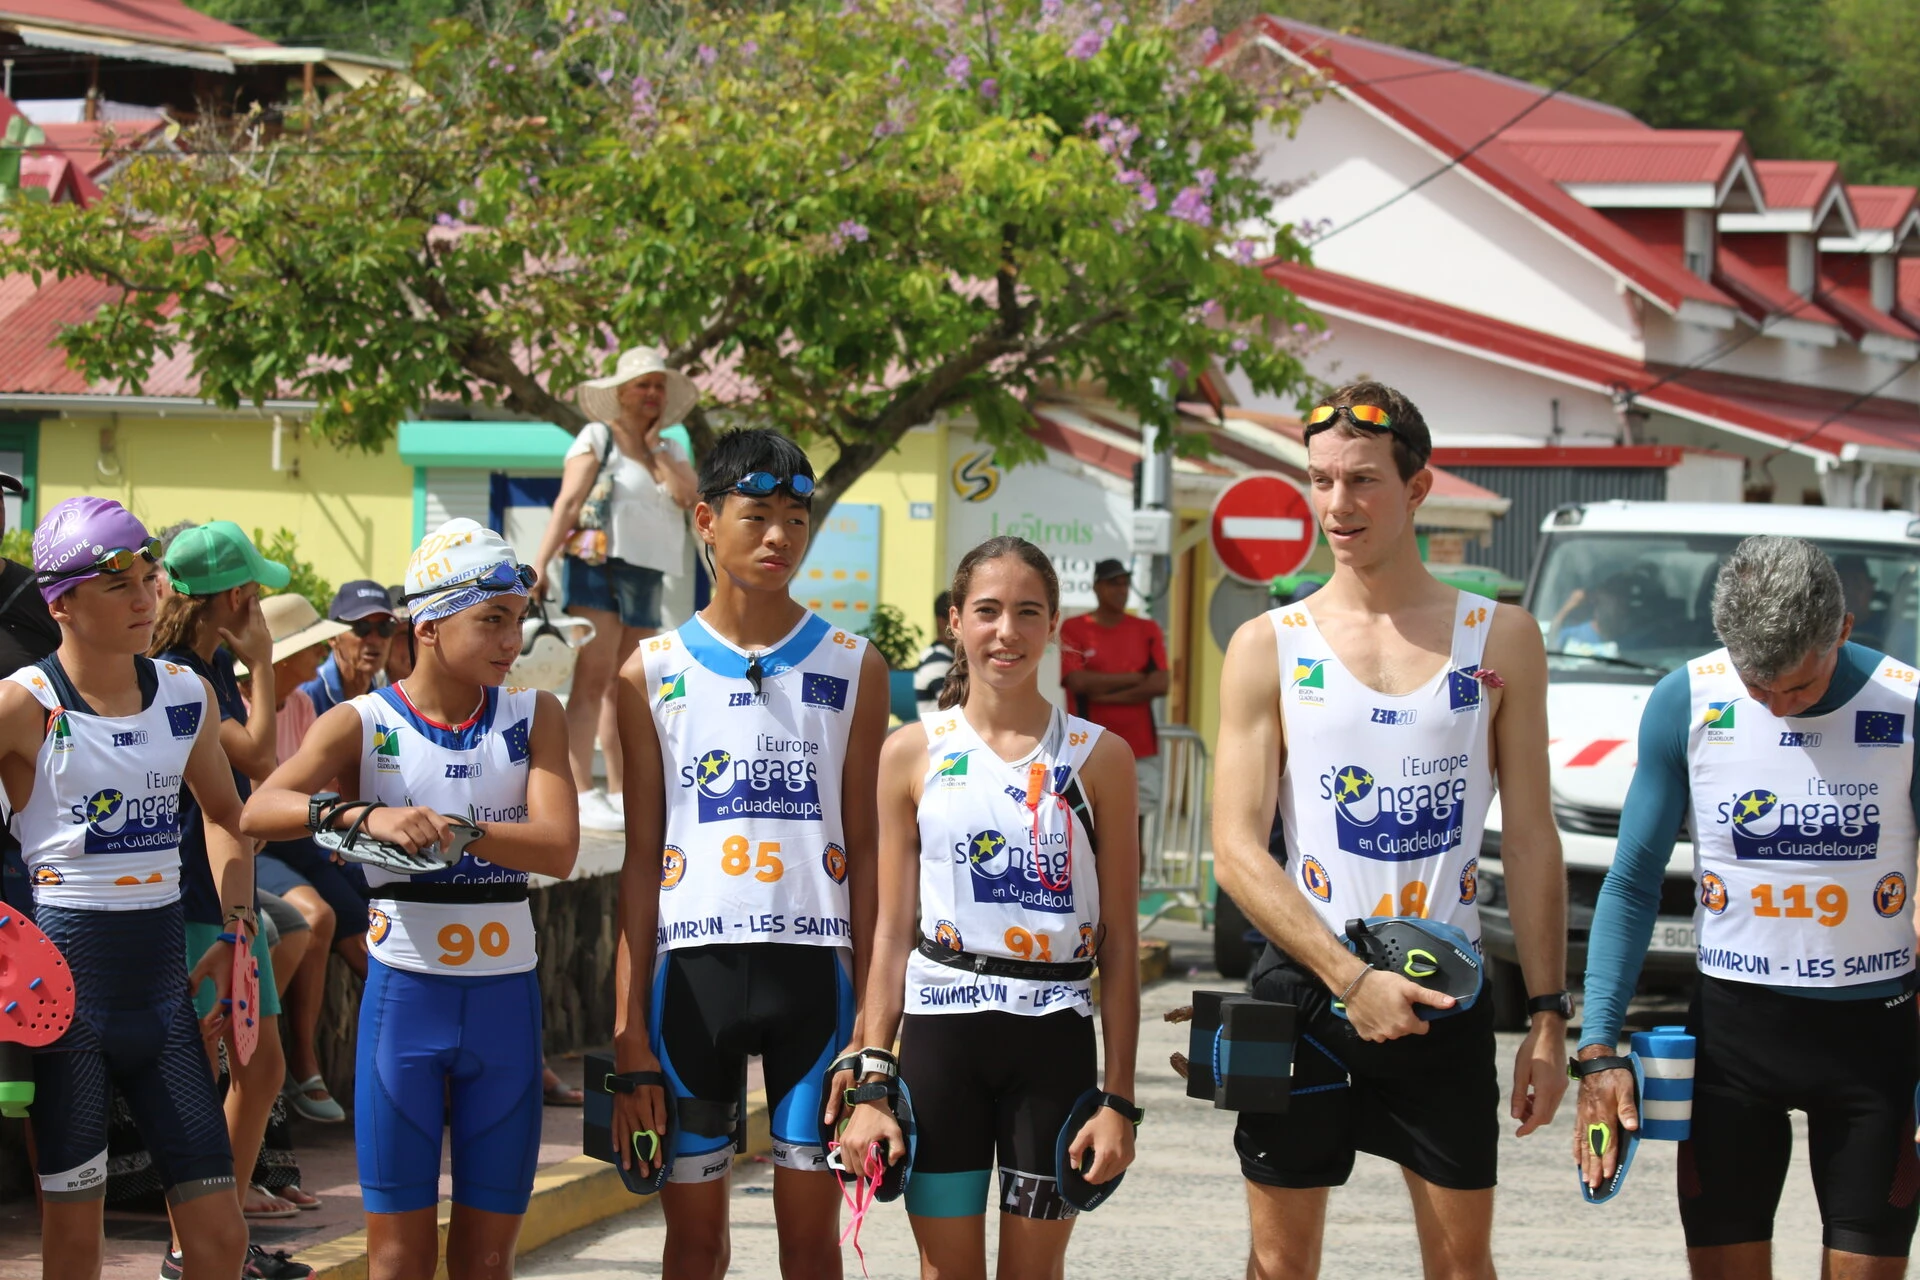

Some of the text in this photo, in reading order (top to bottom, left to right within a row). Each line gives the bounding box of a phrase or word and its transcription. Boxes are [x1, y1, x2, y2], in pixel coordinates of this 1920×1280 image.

[414, 557, 454, 589] TRI
[1282, 612, 1307, 628] 48
[1464, 608, 1487, 628] 48
[649, 636, 671, 652] 85
[833, 631, 857, 649] 85
[1696, 662, 1726, 675] 119
[1883, 668, 1915, 682] 119
[757, 733, 819, 756] l'Europe
[1402, 753, 1469, 778] l'Europe
[1808, 776, 1879, 799] l'Europe
[717, 796, 823, 817] en Guadeloupe
[107, 840, 121, 850] en
[1358, 824, 1462, 854] en Guadeloupe
[1758, 840, 1877, 860] en Guadeloupe
[720, 834, 784, 884] 85
[992, 887, 1006, 898] en
[1750, 883, 1849, 927] 119
[657, 915, 723, 948] SWIMRUN
[749, 913, 786, 935] LES
[437, 921, 510, 966] 90
[1698, 945, 1769, 975] SWIMRUN
[1796, 958, 1837, 979] LES
[1844, 947, 1911, 977] SAINTES
[919, 983, 1008, 1006] SWIMRUN
[1033, 985, 1065, 1008] LES
[67, 1174, 103, 1188] BV SPORT
